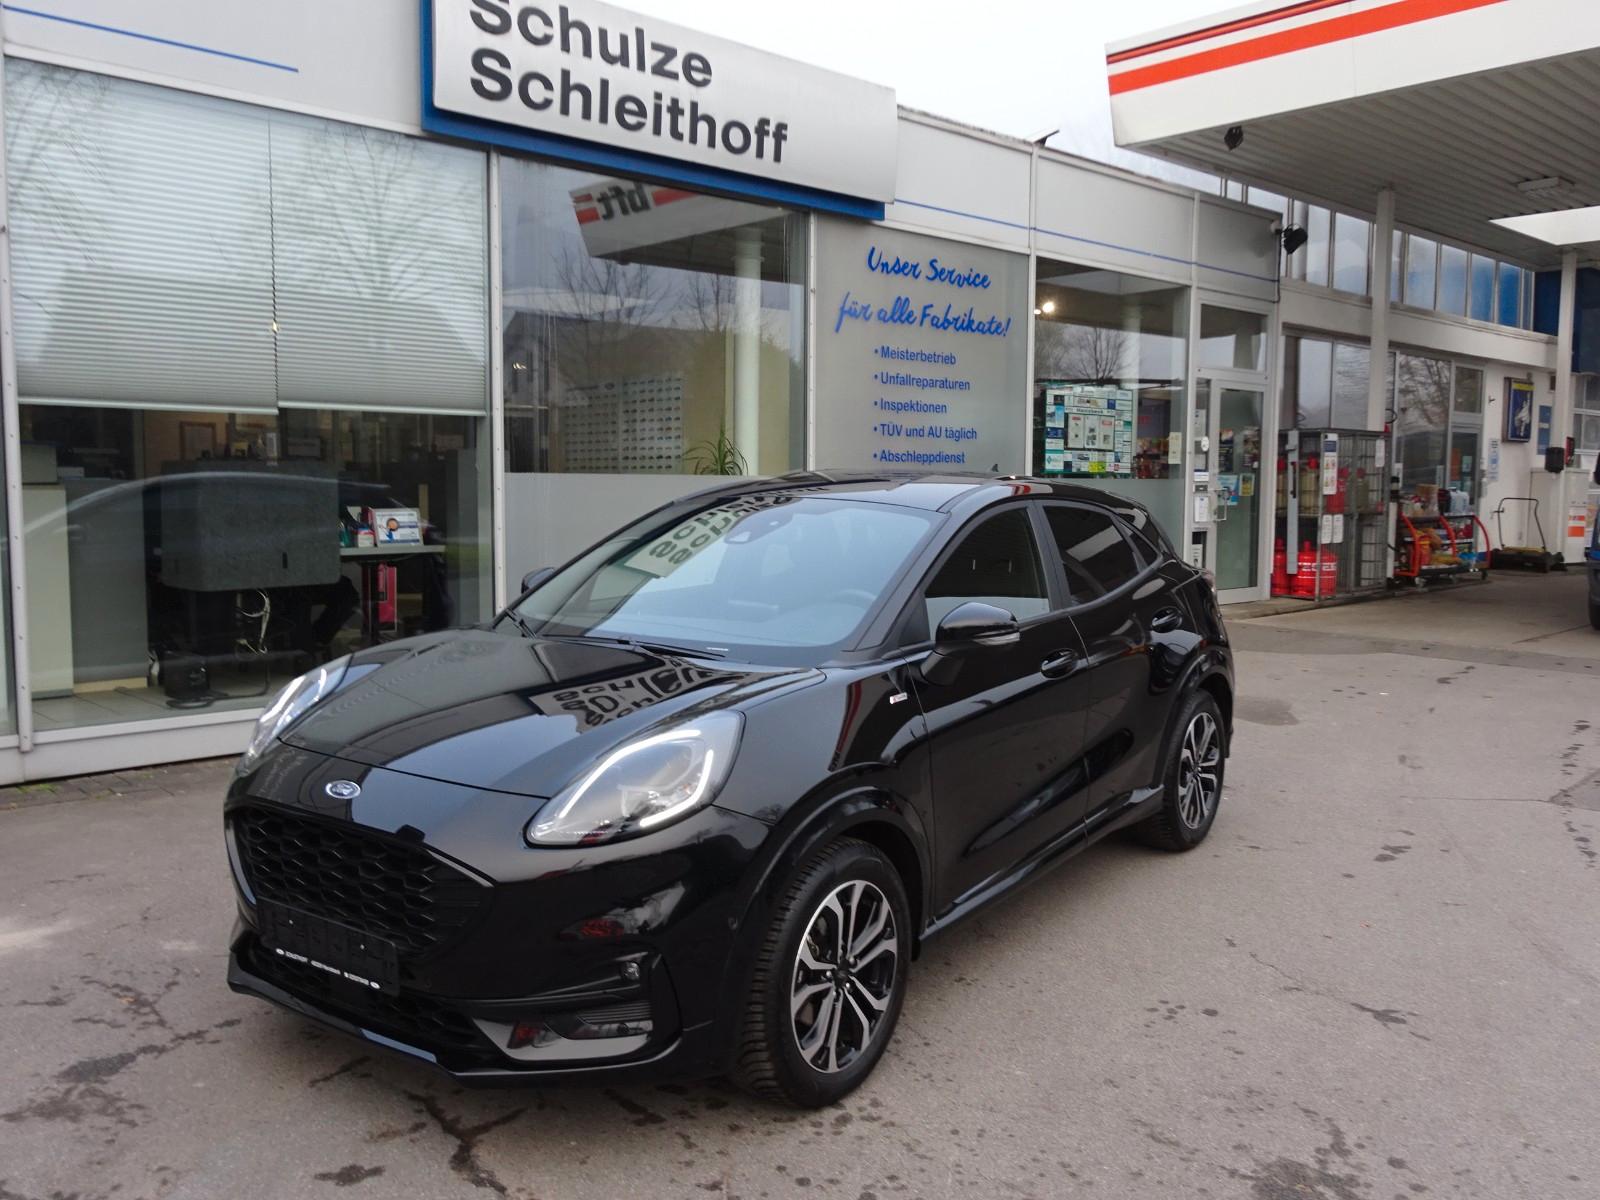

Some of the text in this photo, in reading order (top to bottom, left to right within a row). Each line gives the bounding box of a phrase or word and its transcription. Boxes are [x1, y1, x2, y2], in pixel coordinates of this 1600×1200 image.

[470, 0, 713, 87] Schulze
[470, 48, 788, 163] Schleithoff
[867, 247, 991, 289] Unser Service
[834, 292, 1011, 337] für alle Fabrikate!
[880, 346, 957, 365] Meisterbetrieb
[880, 372, 971, 391] Unfallreparaturen
[880, 398, 947, 414] Inspektionen
[880, 421, 977, 442] TÜV und AU täglich
[880, 449, 966, 466] Abschleppdienst
